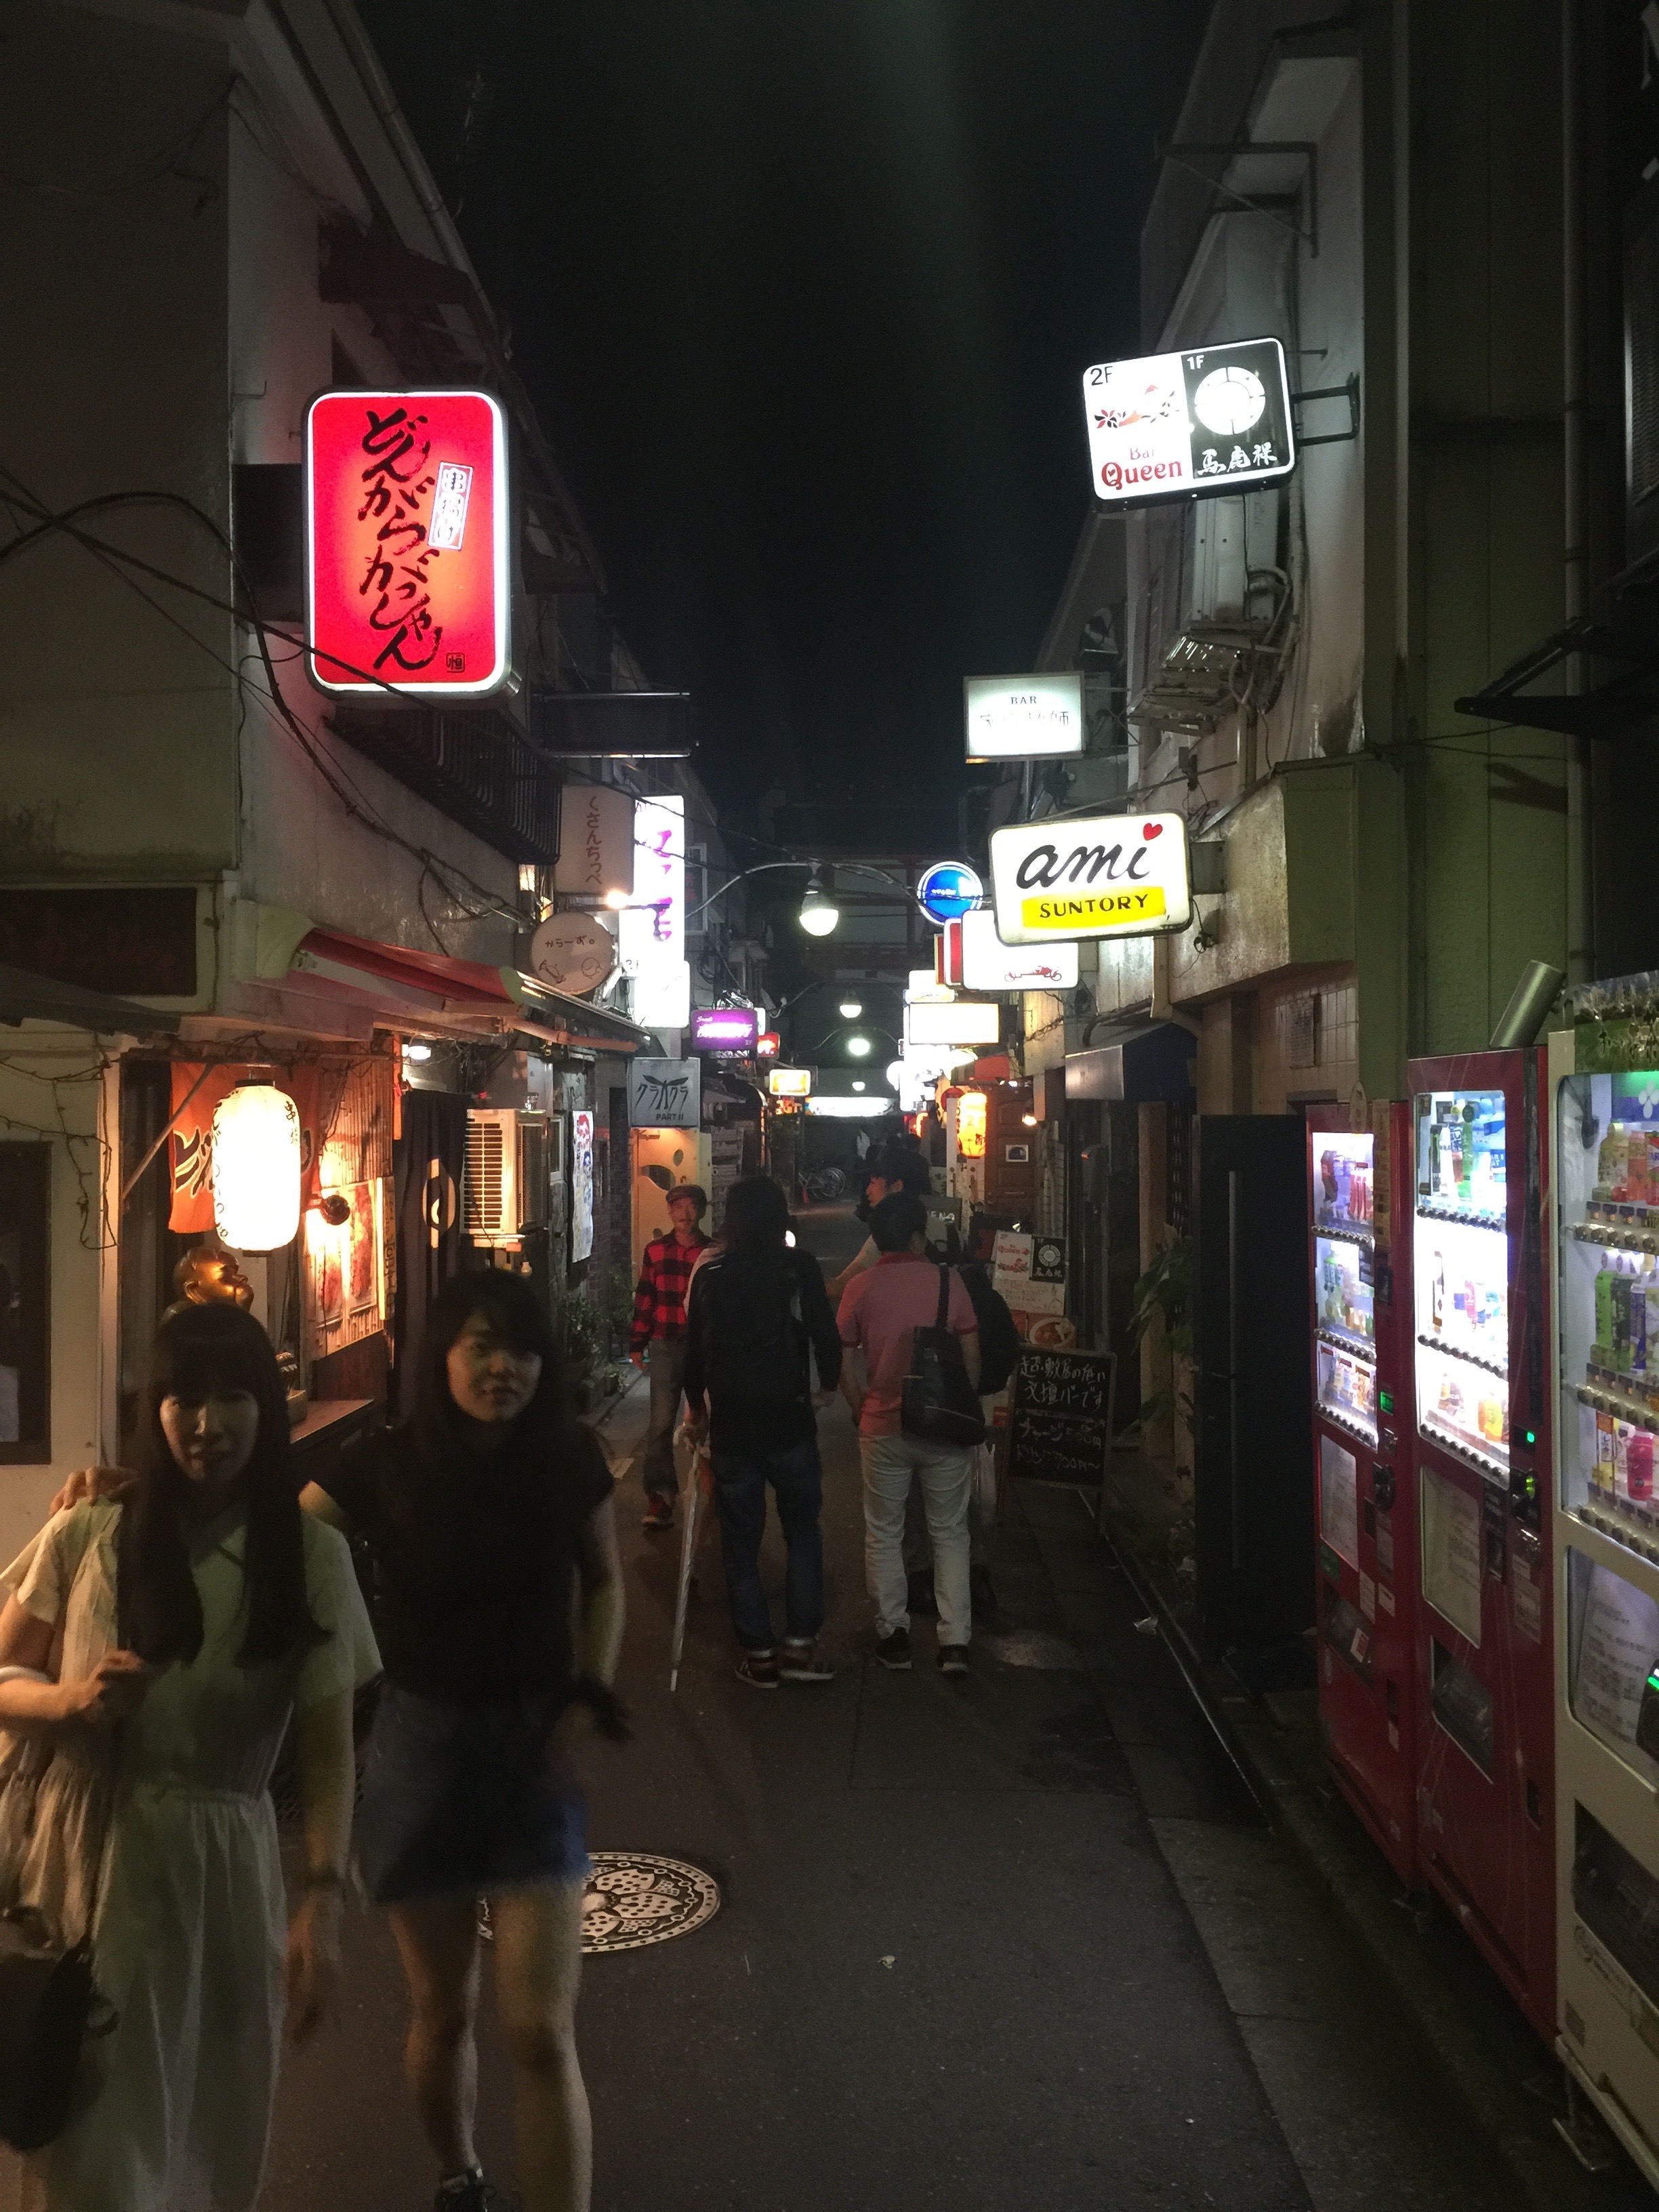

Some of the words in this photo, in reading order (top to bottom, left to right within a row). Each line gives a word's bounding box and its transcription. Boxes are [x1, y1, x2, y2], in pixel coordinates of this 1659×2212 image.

[1187, 354, 1204, 370] 1F
[1090, 366, 1113, 386] 2F
[1101, 461, 1183, 490] Queen
[1010, 695, 1037, 705] BAR
[1017, 823, 1163, 889] ami
[1039, 893, 1149, 919] SUNTORY
